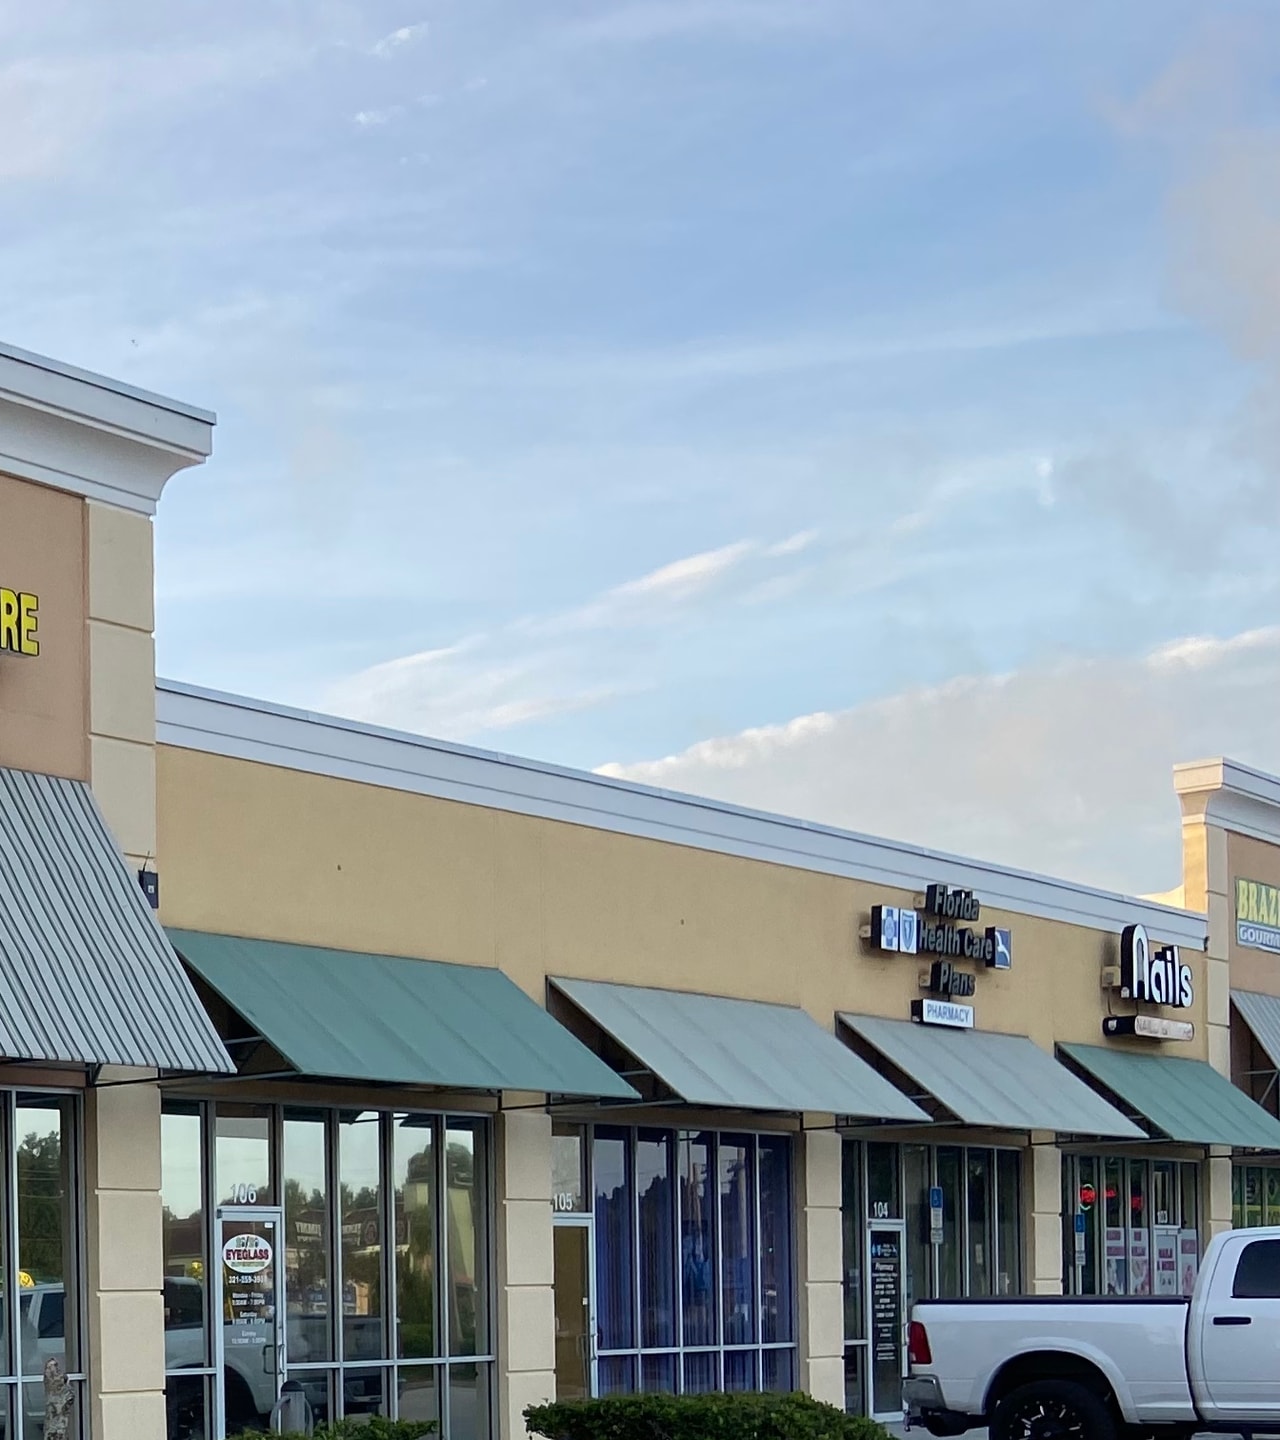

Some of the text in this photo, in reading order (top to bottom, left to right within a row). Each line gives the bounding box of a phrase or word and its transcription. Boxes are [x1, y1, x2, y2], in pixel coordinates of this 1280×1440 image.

[934, 884, 980, 920] Florida
[920, 921, 993, 960] Health Care
[1132, 924, 1194, 1008] Nails
[939, 961, 976, 995] Plans
[926, 1004, 971, 1022] PHARMACY
[231, 1183, 257, 1204] 106
[553, 1193, 573, 1210] 105
[873, 1202, 889, 1218] 104
[226, 1249, 269, 1260] EYEGLASS
